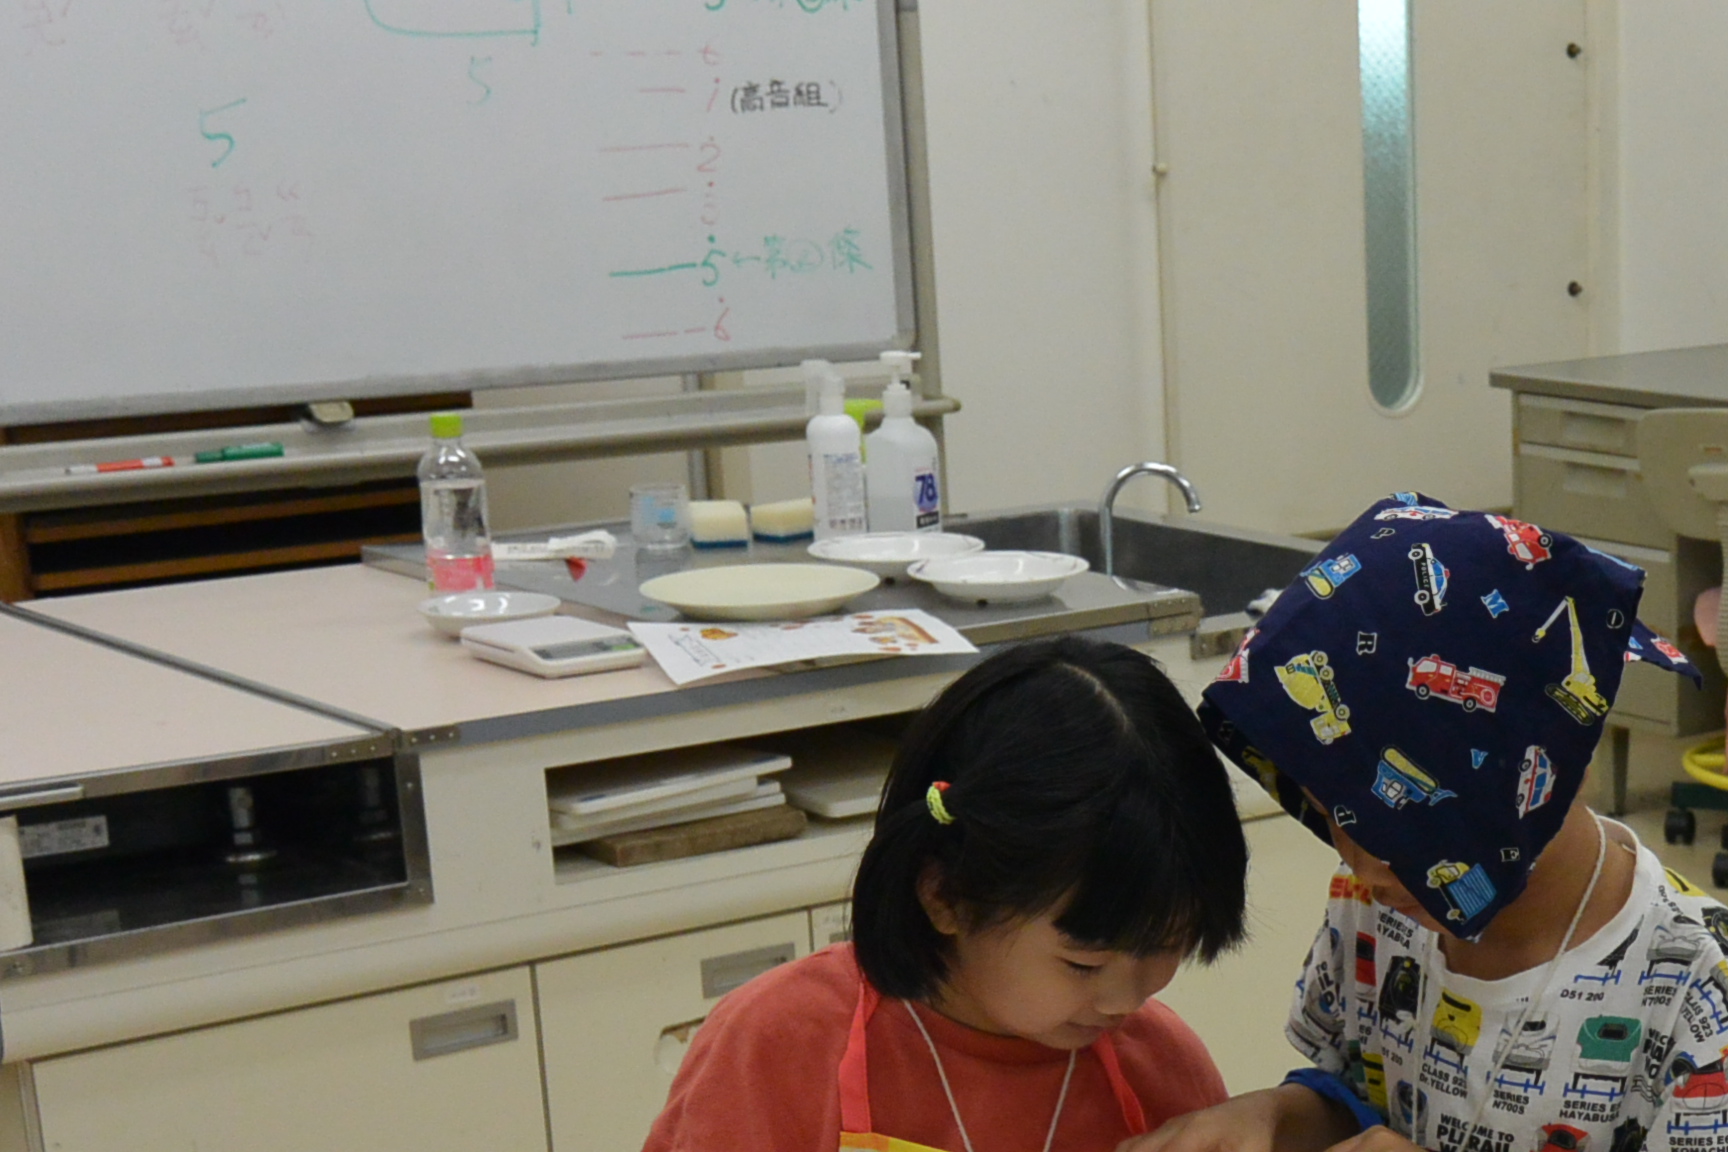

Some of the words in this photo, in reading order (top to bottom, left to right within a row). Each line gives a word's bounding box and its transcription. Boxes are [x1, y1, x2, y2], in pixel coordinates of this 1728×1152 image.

[196, 97, 247, 168] 5
[914, 472, 938, 504] 78
[1420, 561, 1430, 589] POLICE
[1421, 1063, 1450, 1082] CLASS
[1492, 1089, 1530, 1105] SERIES
[1492, 1100, 1525, 1115] N700S
[1563, 1100, 1606, 1113] SERIES
[1498, 1131, 1515, 1143] TO
[1668, 1136, 1713, 1147] SERIES
